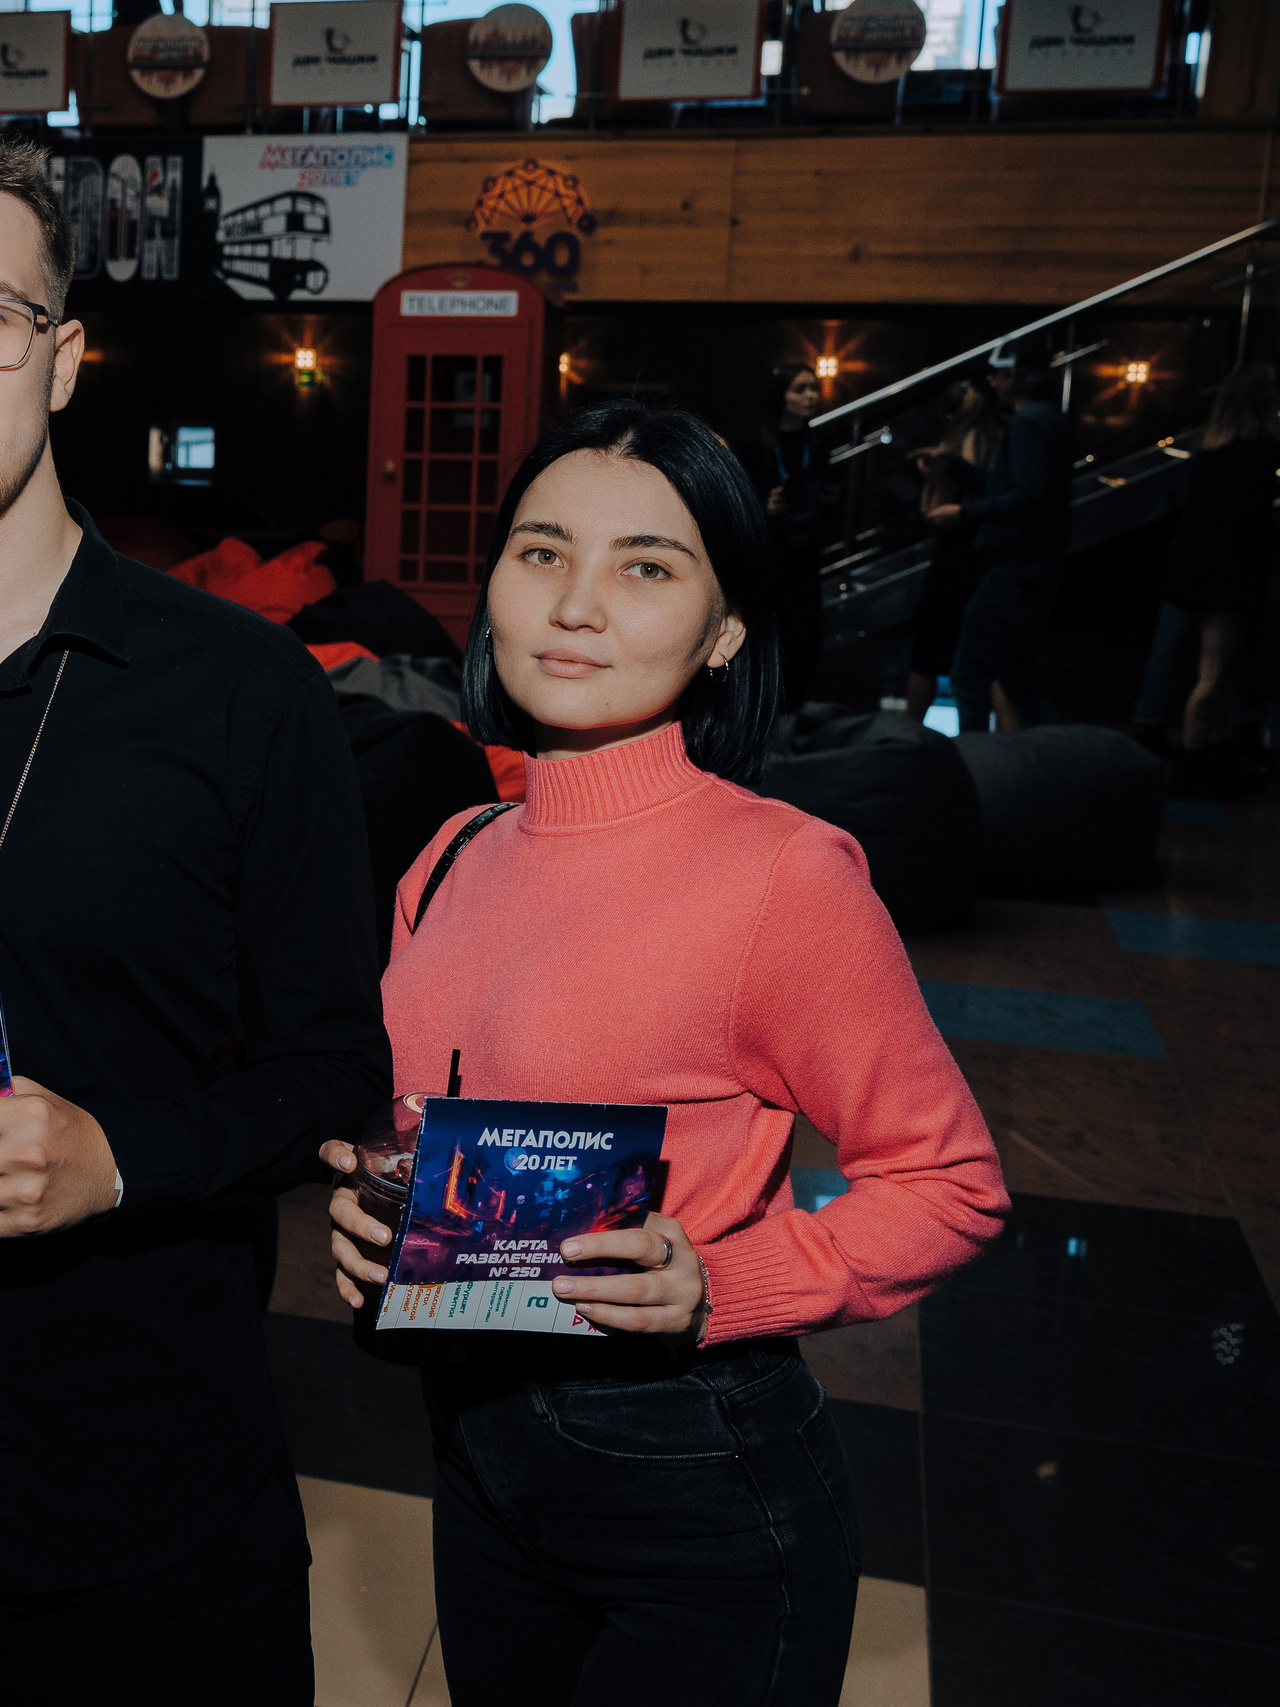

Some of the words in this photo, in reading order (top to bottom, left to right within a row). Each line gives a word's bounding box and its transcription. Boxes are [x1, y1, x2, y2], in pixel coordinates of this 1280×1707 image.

[481, 230, 581, 277] 360
[407, 295, 511, 313] TELEPHONE
[477, 1127, 614, 1150] МЕГАПОЛИС
[515, 1154, 541, 1170] 20
[541, 1155, 577, 1170] ЛЕТ
[493, 1239, 549, 1251] КАРТА
[488, 1267, 508, 1278] №
[509, 1266, 541, 1278] 250
[409, 1288, 423, 1321] бекской
[422, 1288, 432, 1306] стол
[428, 1285, 442, 1318] ведский
[448, 1284, 462, 1318] напитки
